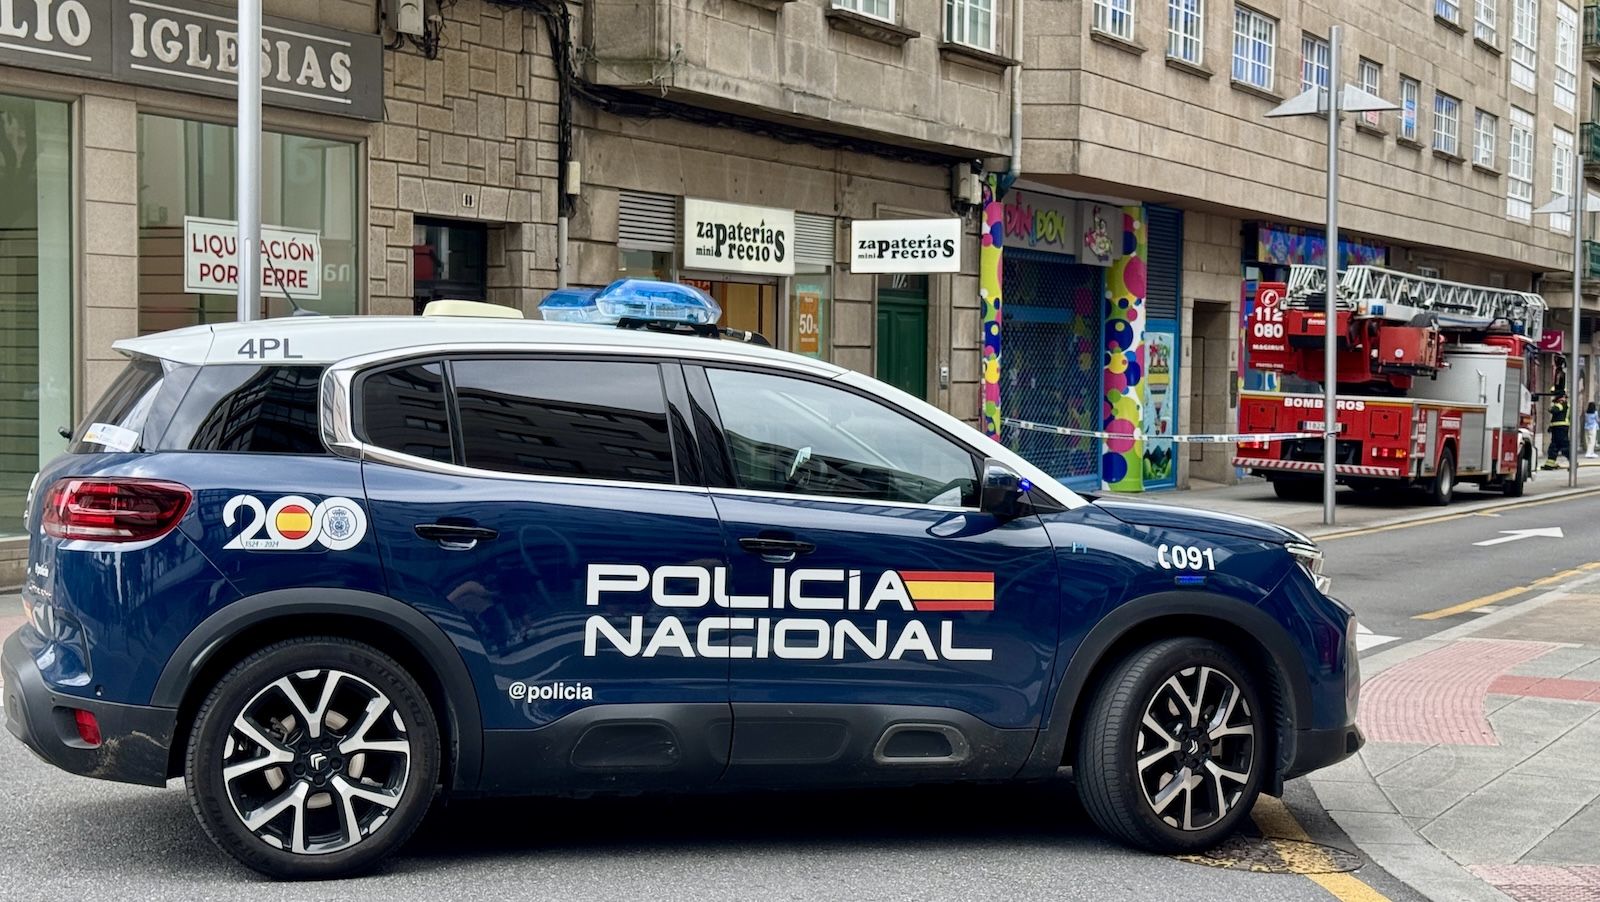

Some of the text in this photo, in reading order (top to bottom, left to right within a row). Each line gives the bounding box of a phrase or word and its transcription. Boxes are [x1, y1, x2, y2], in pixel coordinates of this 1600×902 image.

[193, 233, 314, 262] LIQUACIÓN
[200, 263, 238, 283] POR
[1255, 307, 1283, 322] 112
[1254, 323, 1284, 338] 080
[238, 338, 303, 359] 4PL
[1284, 398, 1365, 411] BOMBROS
[583, 616, 993, 661] NACIONAL
[508, 682, 593, 702] @policia
